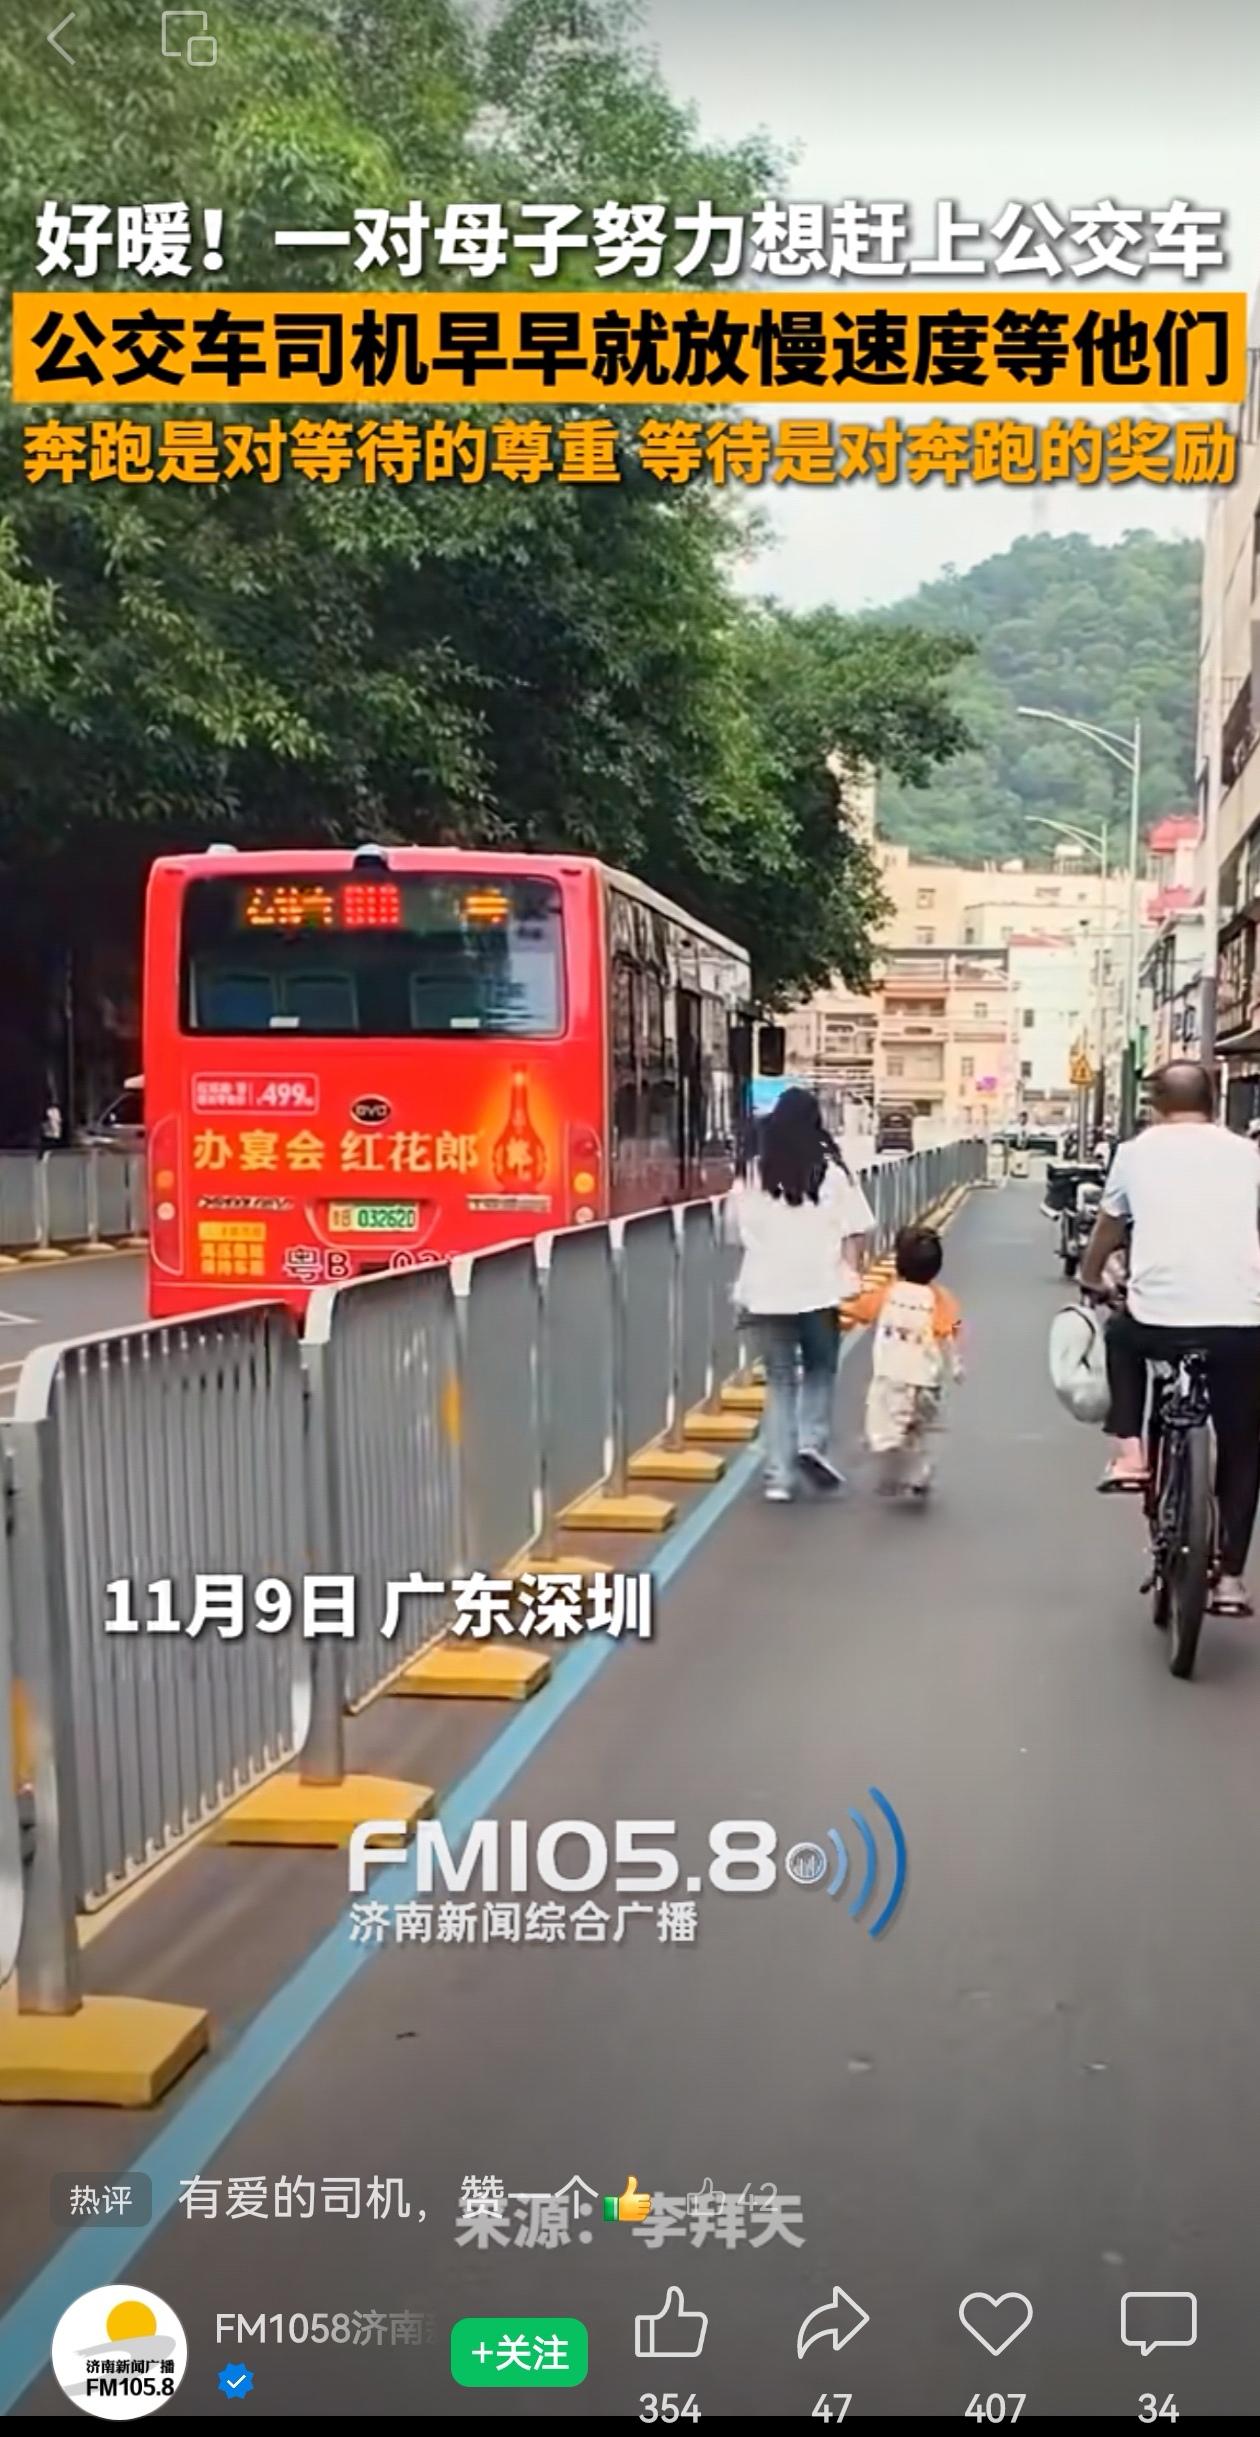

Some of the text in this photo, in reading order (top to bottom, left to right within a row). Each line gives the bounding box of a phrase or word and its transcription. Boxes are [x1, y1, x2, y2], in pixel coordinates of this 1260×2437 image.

[193, 1129, 325, 1171] 办宴会
[339, 1129, 482, 1174] 红花郎
